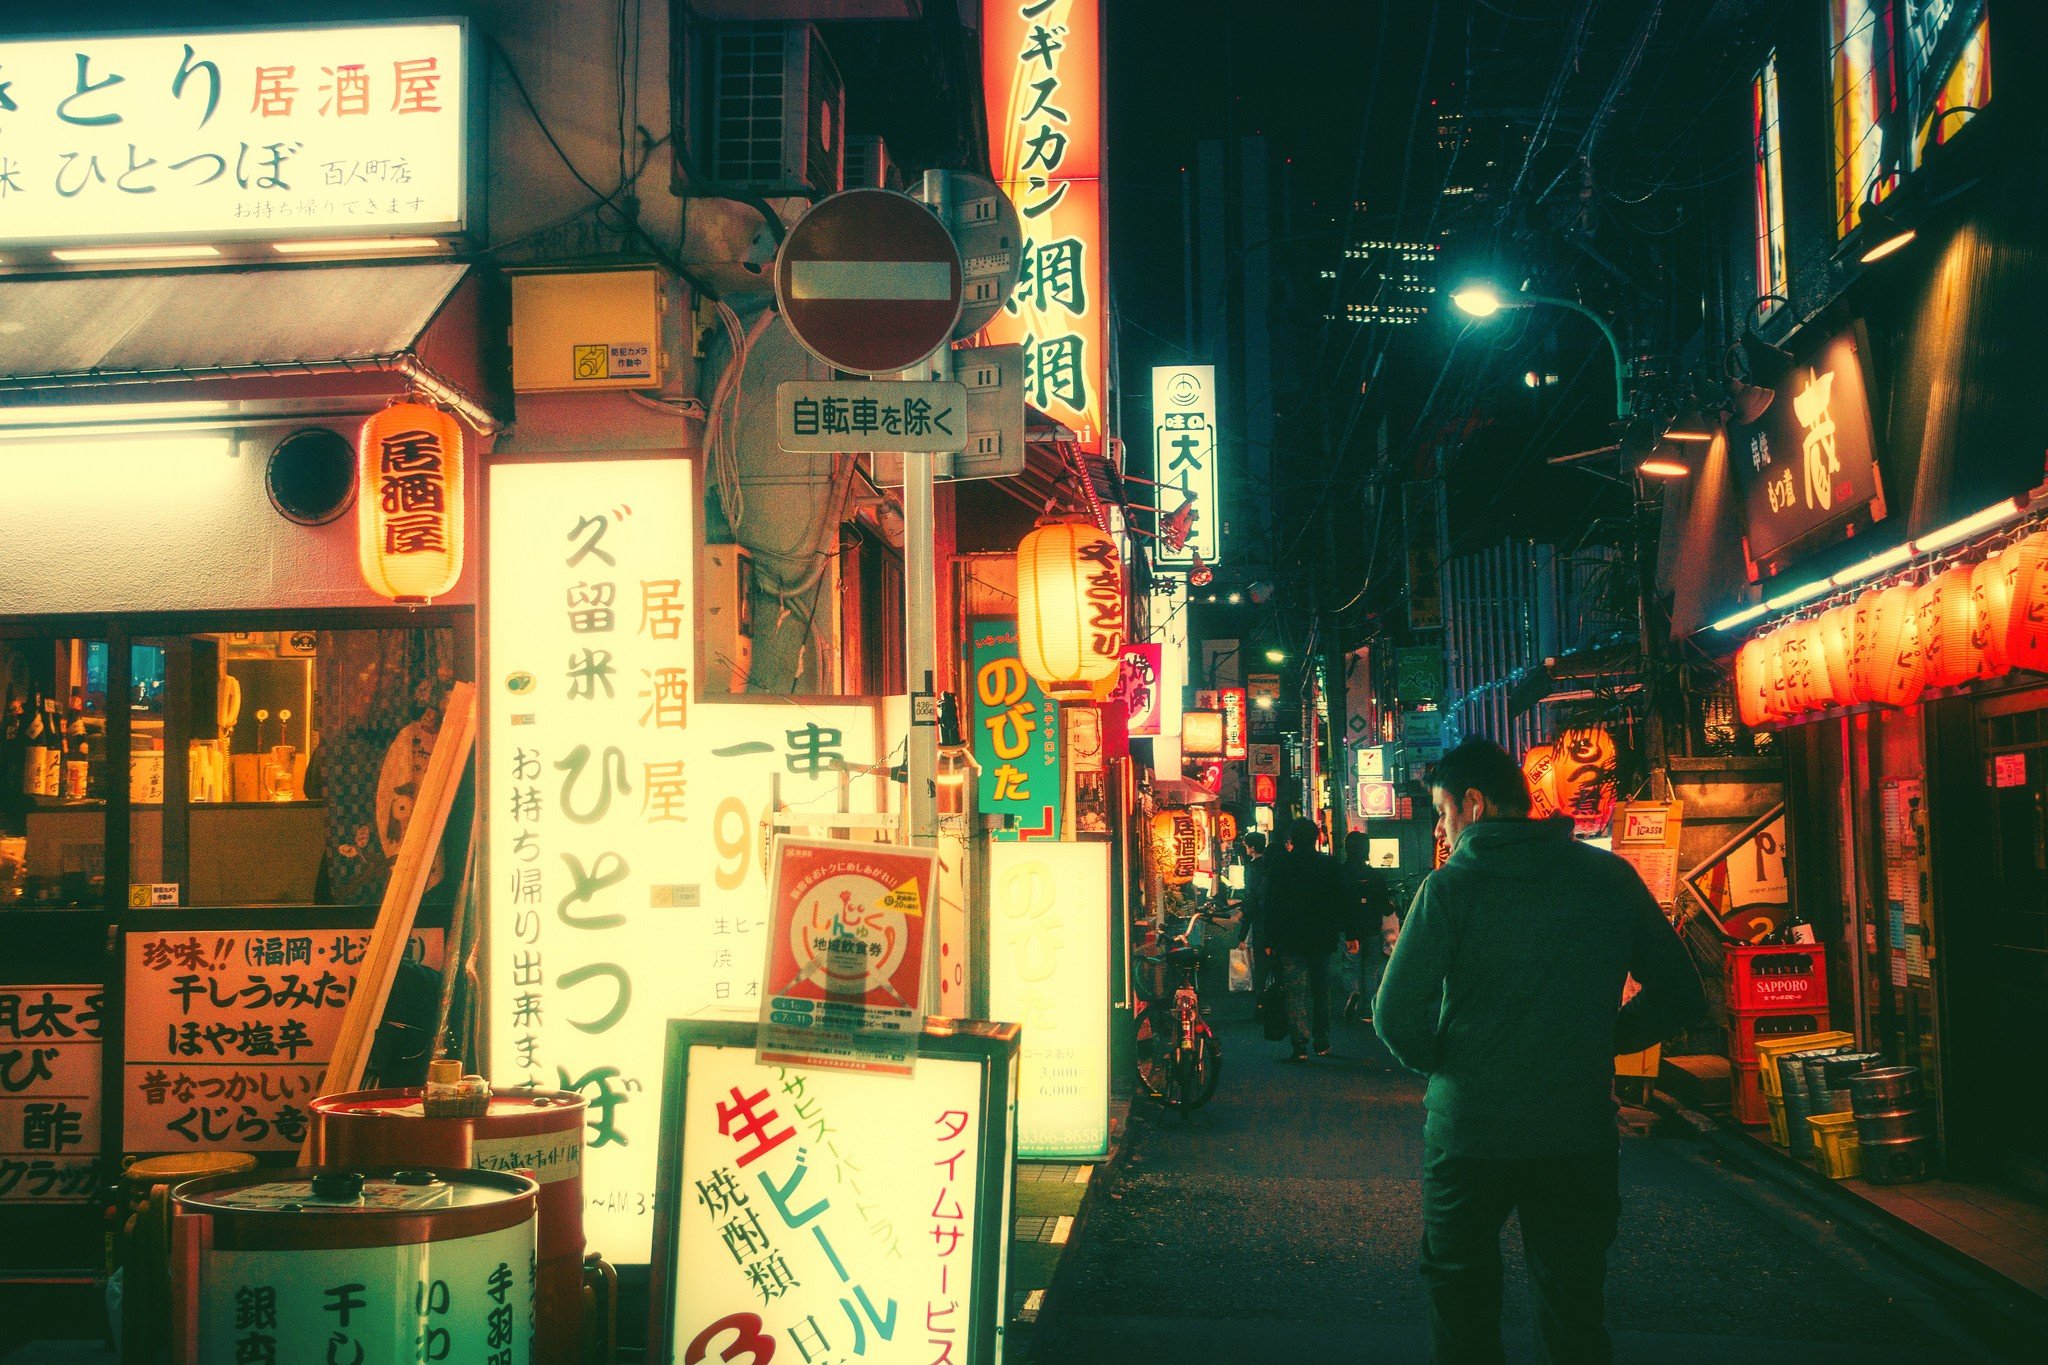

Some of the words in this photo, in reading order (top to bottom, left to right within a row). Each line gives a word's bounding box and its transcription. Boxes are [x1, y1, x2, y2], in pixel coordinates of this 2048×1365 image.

[250, 57, 443, 118] 居酒屋
[56, 141, 304, 198] ひとつぼ
[320, 158, 413, 186] 百人町店
[234, 197, 425, 219] お持ち帰りできます
[794, 397, 953, 436] 自転車を除く
[380, 430, 447, 557] 居酒屋
[1080, 540, 1122, 660] やきとり
[637, 578, 690, 825] 居酒屋
[977, 657, 1038, 802] のびた
[1044, 695, 1056, 766] ステサロン
[1173, 815, 1197, 877] 居酒屋
[143, 937, 234, 971] 珍味!!
[169, 971, 357, 1015] 干しうみた
[1756, 979, 1808, 993] SAPPORO
[168, 1018, 313, 1060] ほや塩辛
[23, 1103, 83, 1153] 酢
[695, 1166, 802, 1308] 焼酎類
[715, 1086, 898, 1357] 生ビール
[787, 1315, 848, 1365] 日
